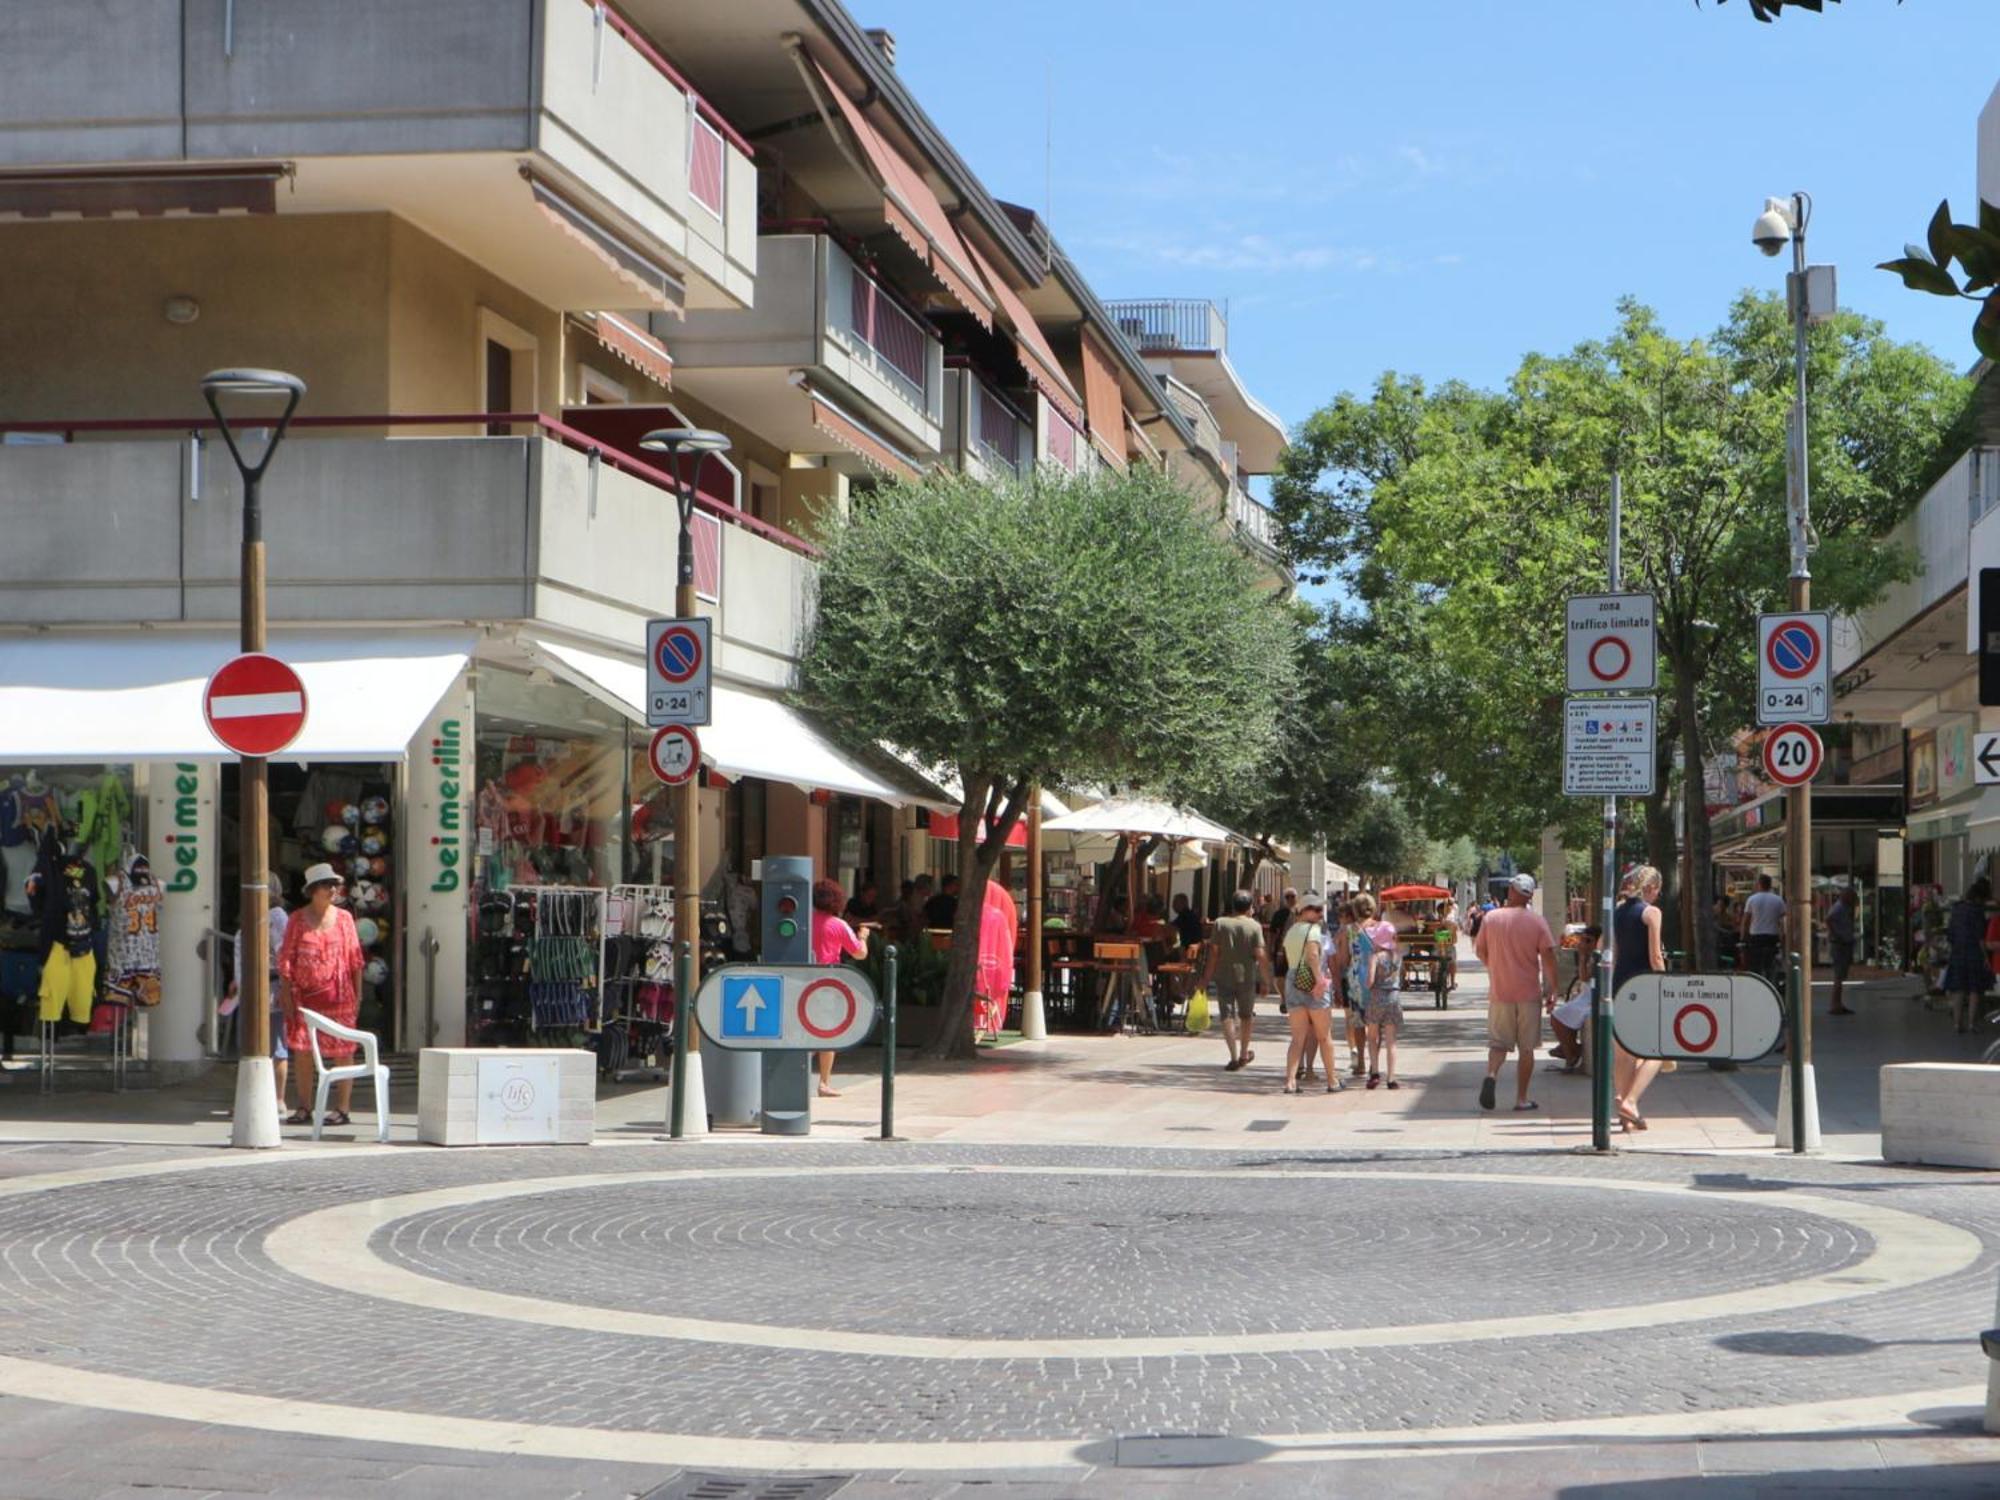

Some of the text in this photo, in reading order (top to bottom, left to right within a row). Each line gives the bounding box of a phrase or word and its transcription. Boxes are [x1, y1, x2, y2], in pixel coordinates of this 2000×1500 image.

[1599, 602, 1620, 611] zona
[1571, 617, 1650, 630] traffico limitato
[655, 697, 687, 710] 0-24
[1767, 694, 1803, 707] 0-24
[1777, 740, 1806, 767] 20
[431, 719, 460, 892] bei merilin
[165, 834, 198, 892] bei
[1697, 990, 1728, 1000] limitato
